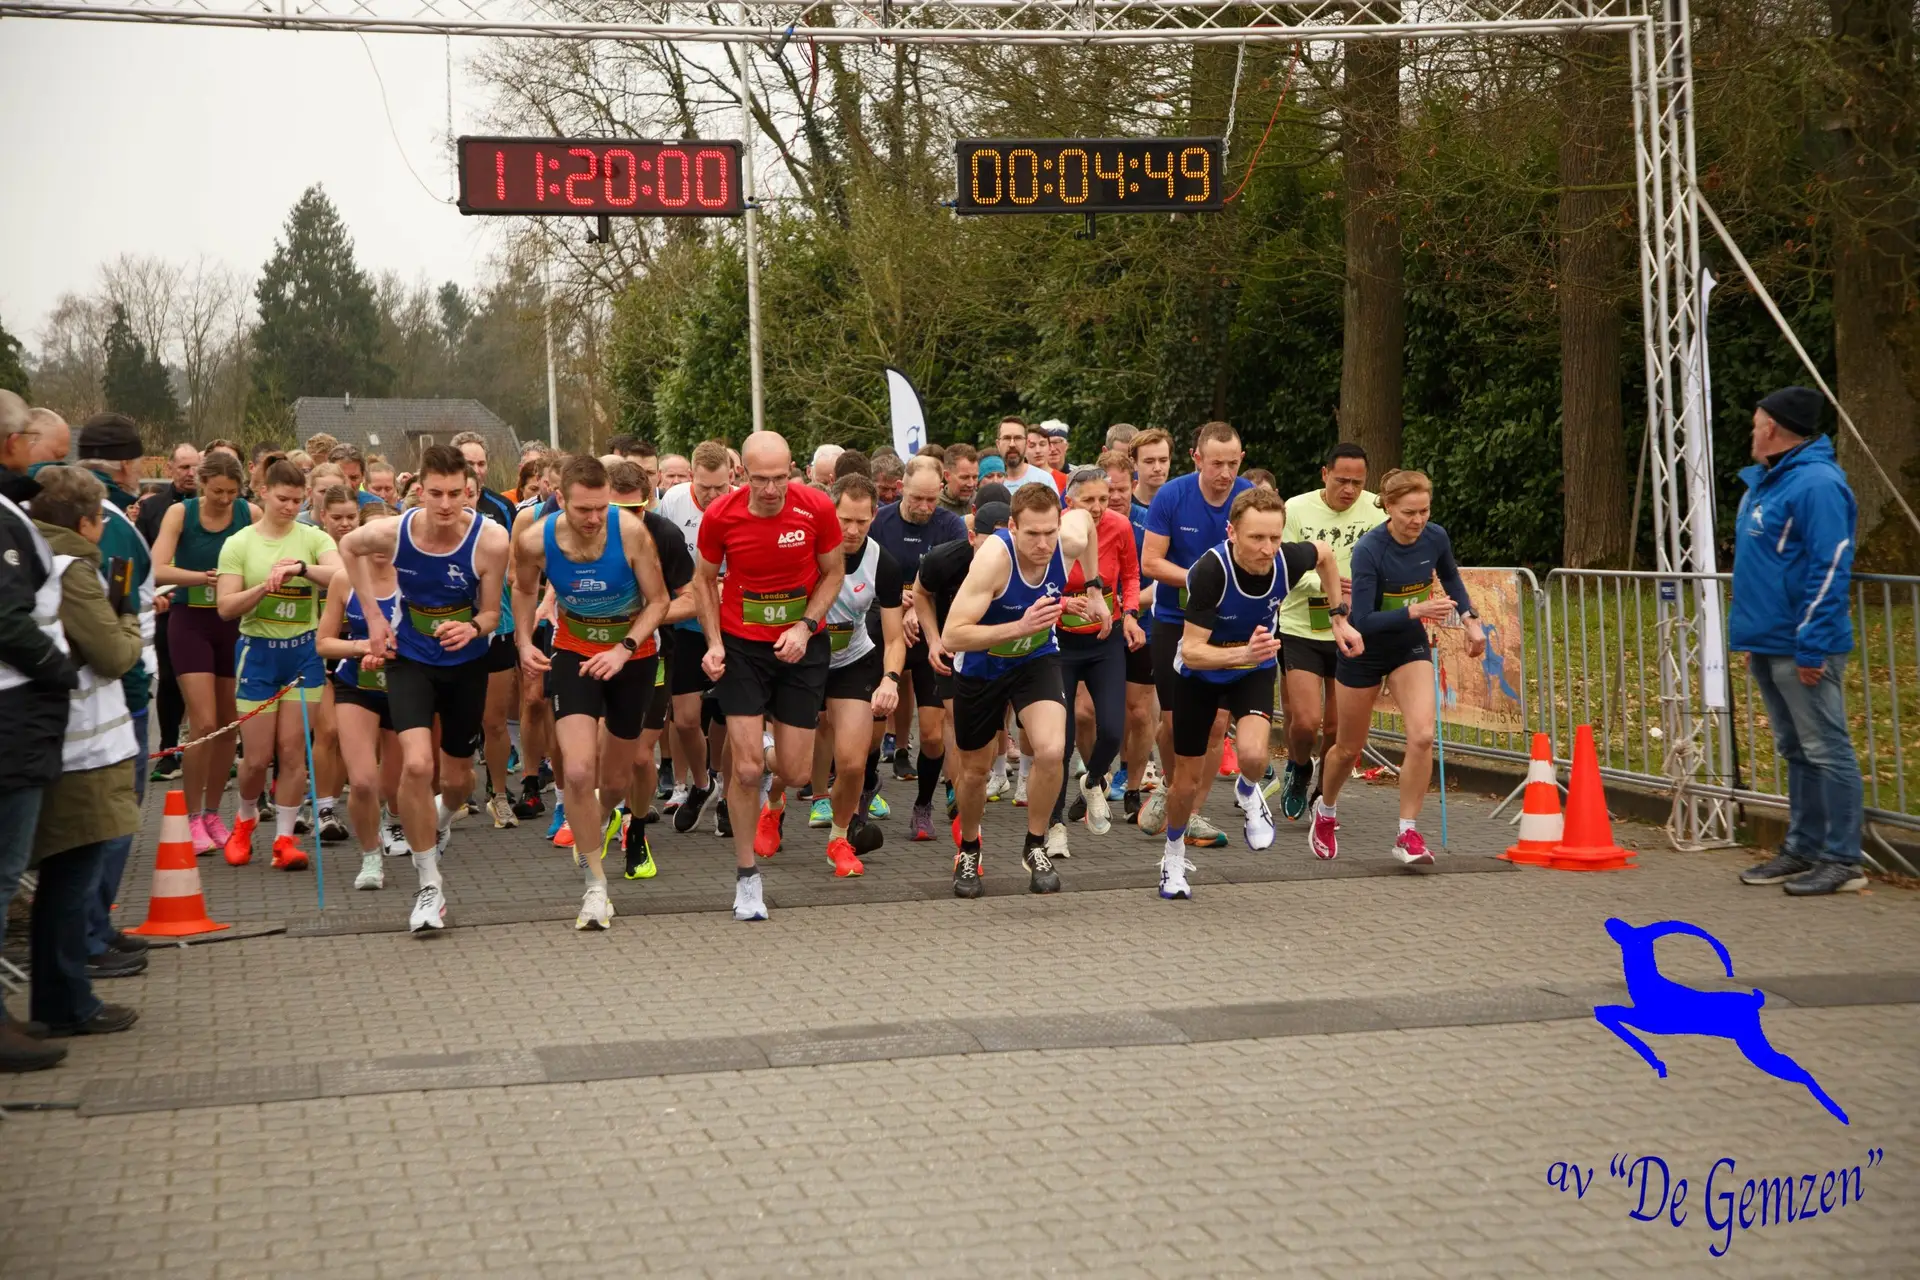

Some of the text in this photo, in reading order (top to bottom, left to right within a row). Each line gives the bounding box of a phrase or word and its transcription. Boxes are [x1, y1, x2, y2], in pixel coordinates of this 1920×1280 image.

[496, 148, 727, 206] 11:20:00
[972, 147, 1210, 204] 00:04:49
[275, 601, 297, 619] 40
[763, 605, 787, 621] 94
[586, 628, 610, 641] 26
[1012, 636, 1031, 652] 74
